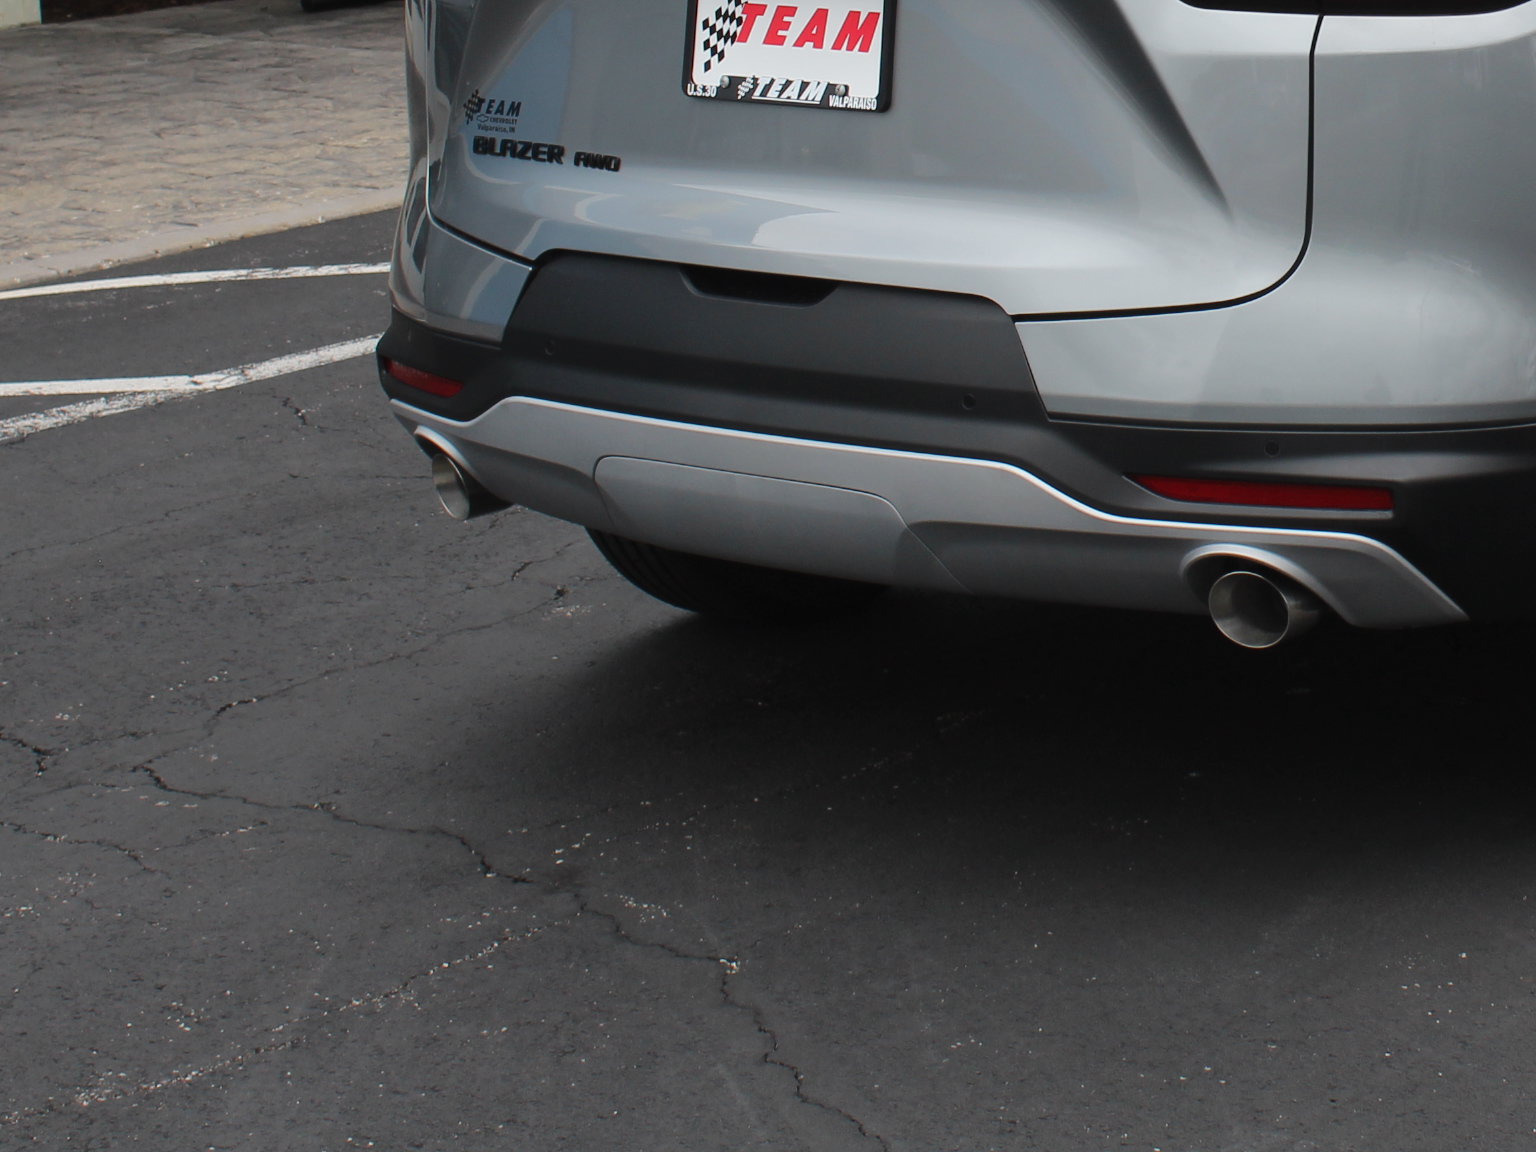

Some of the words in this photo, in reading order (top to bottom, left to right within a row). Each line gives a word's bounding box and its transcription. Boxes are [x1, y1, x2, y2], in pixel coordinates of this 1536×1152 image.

[736, 2, 881, 53] TEAM
[752, 76, 829, 102] TEAM
[477, 98, 522, 118] TEAM
[828, 95, 878, 111] VALPARAISO
[489, 116, 518, 126] CHEVROLET
[472, 135, 565, 165] BLAZER
[573, 151, 622, 173] AWD
